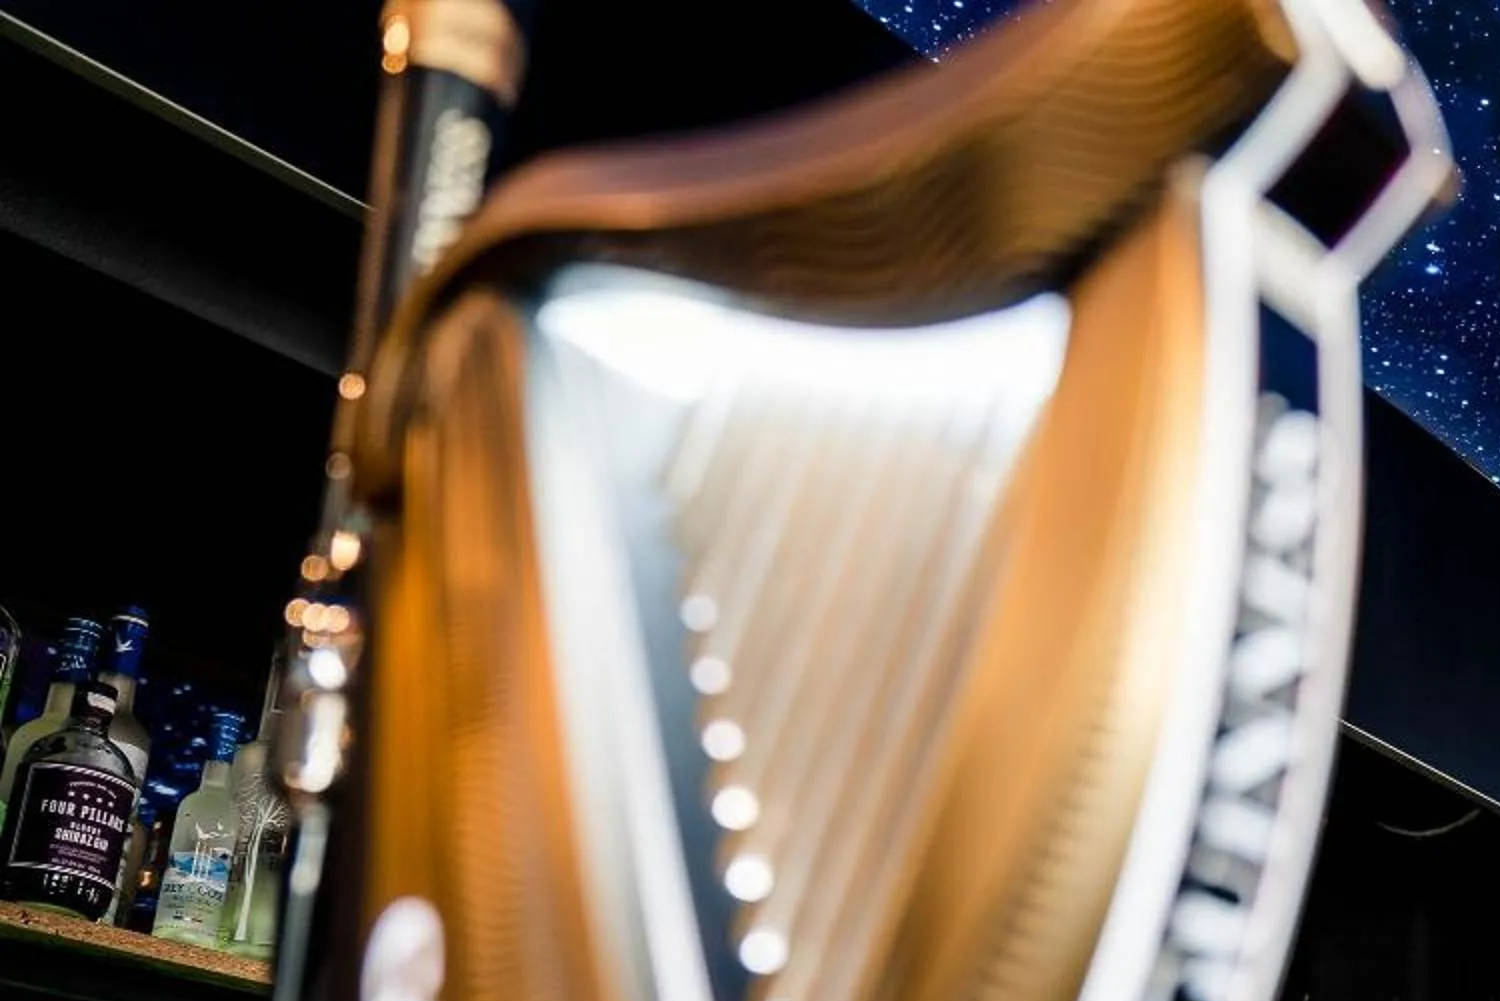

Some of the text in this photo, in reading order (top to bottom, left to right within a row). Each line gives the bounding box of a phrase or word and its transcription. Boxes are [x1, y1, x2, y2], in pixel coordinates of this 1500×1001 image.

[41, 799, 125, 833] FOUR PILLARS
[54, 828, 93, 848] SHIRAZ
